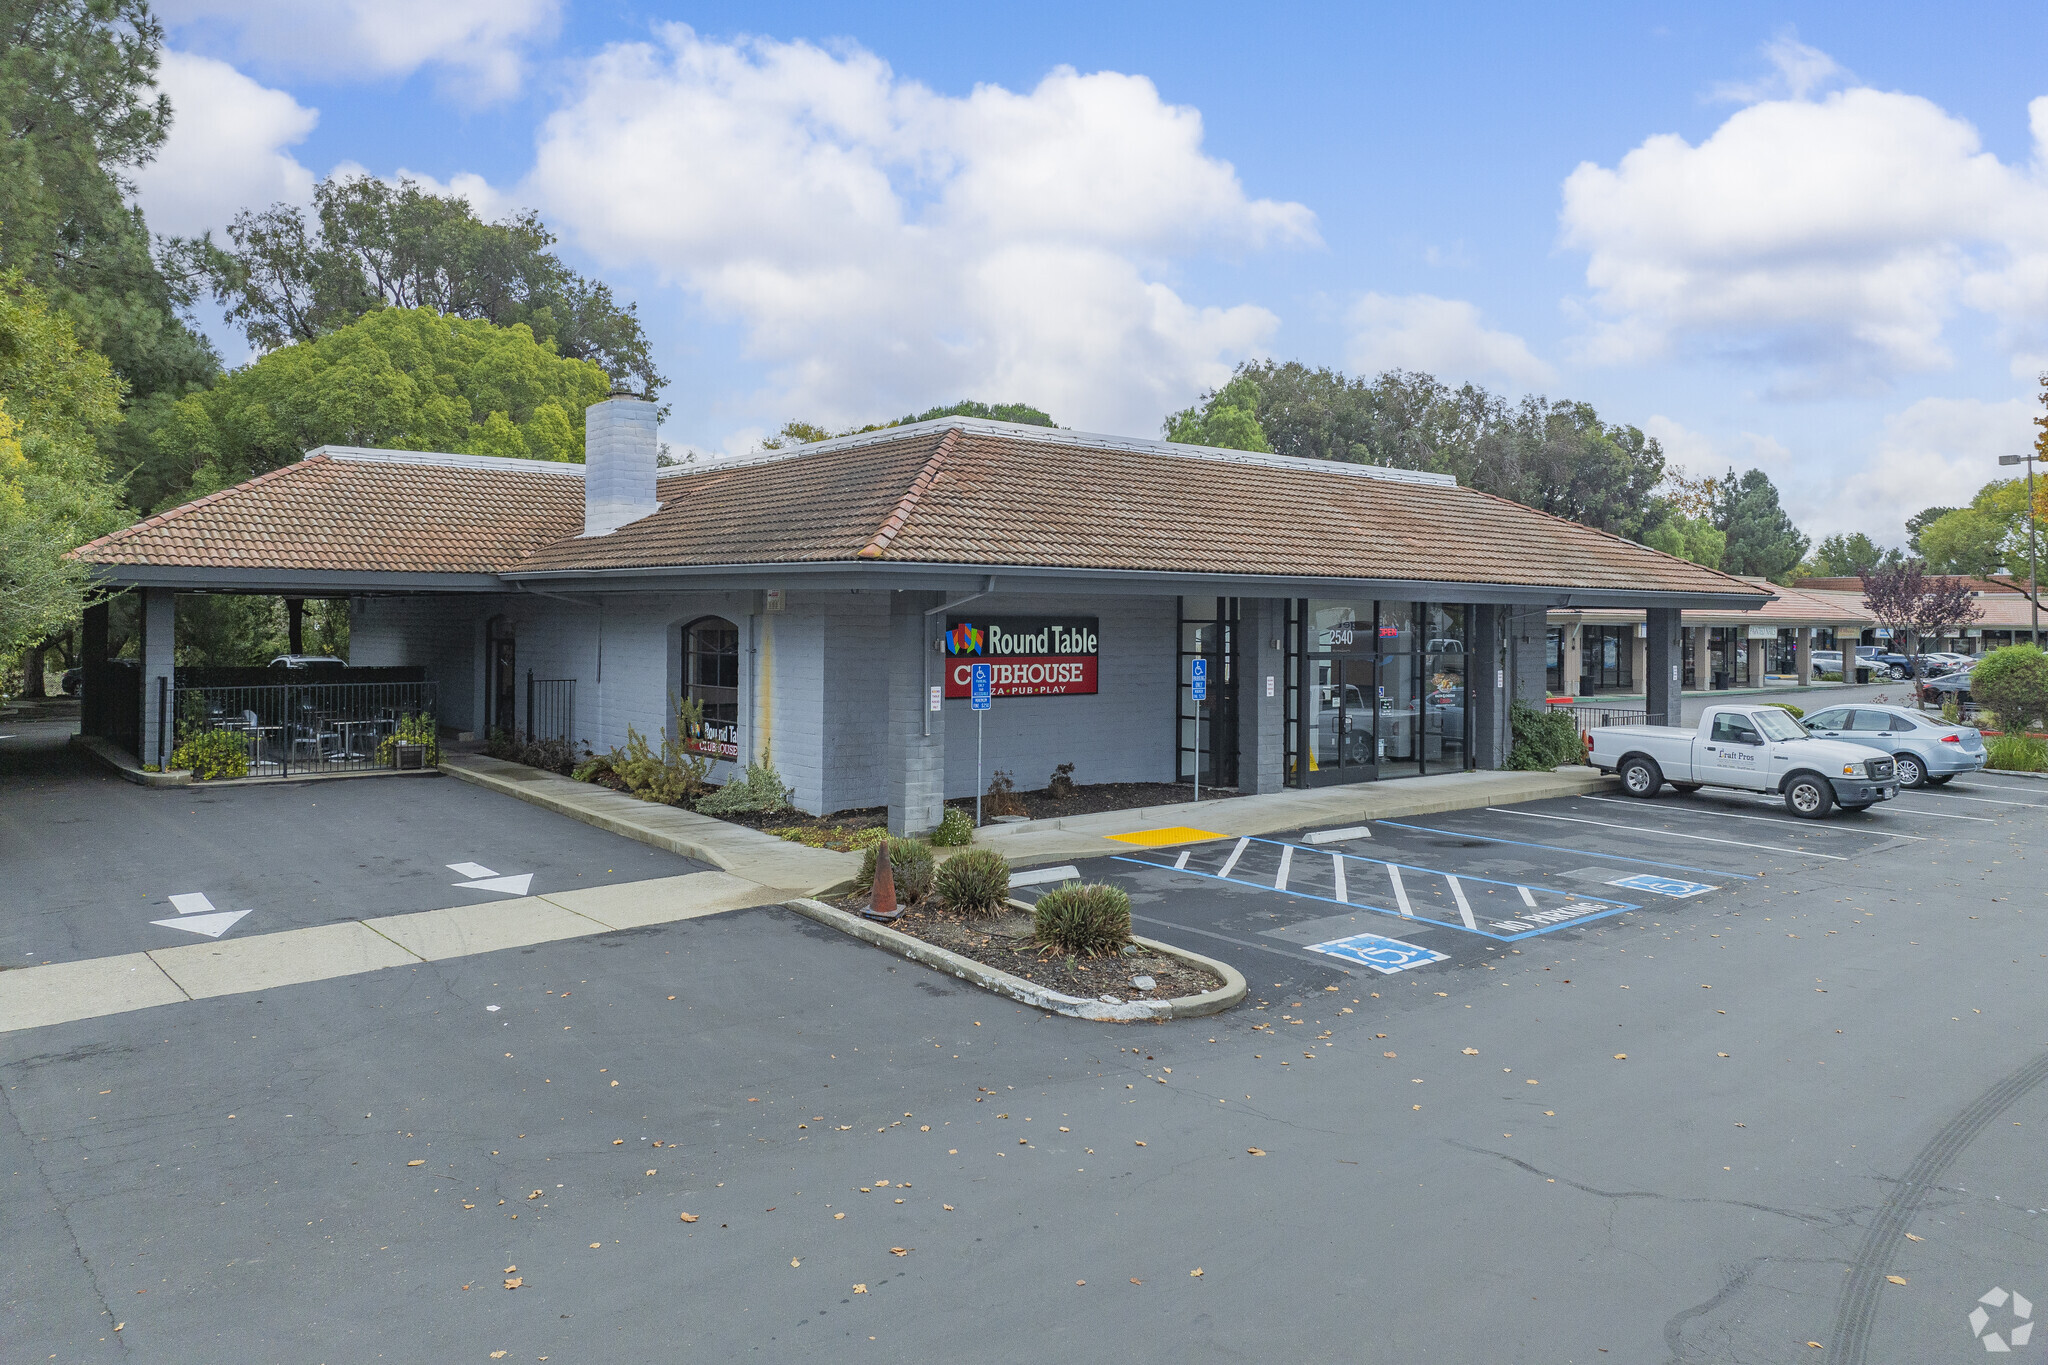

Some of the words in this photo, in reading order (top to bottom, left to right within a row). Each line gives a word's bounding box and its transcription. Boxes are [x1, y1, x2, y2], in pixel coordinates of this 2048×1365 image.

[989, 625, 1048, 654] Round
[1052, 625, 1097, 653] Table
[1330, 630, 1353, 644] 2540
[954, 663, 1083, 685] CUBHOUSE
[1012, 686, 1032, 694] PUB
[1040, 685, 1066, 693] PLAY
[1738, 752, 1754, 761] Pros
[1488, 920, 1534, 932] NO
[1520, 902, 1608, 924] PARKING
